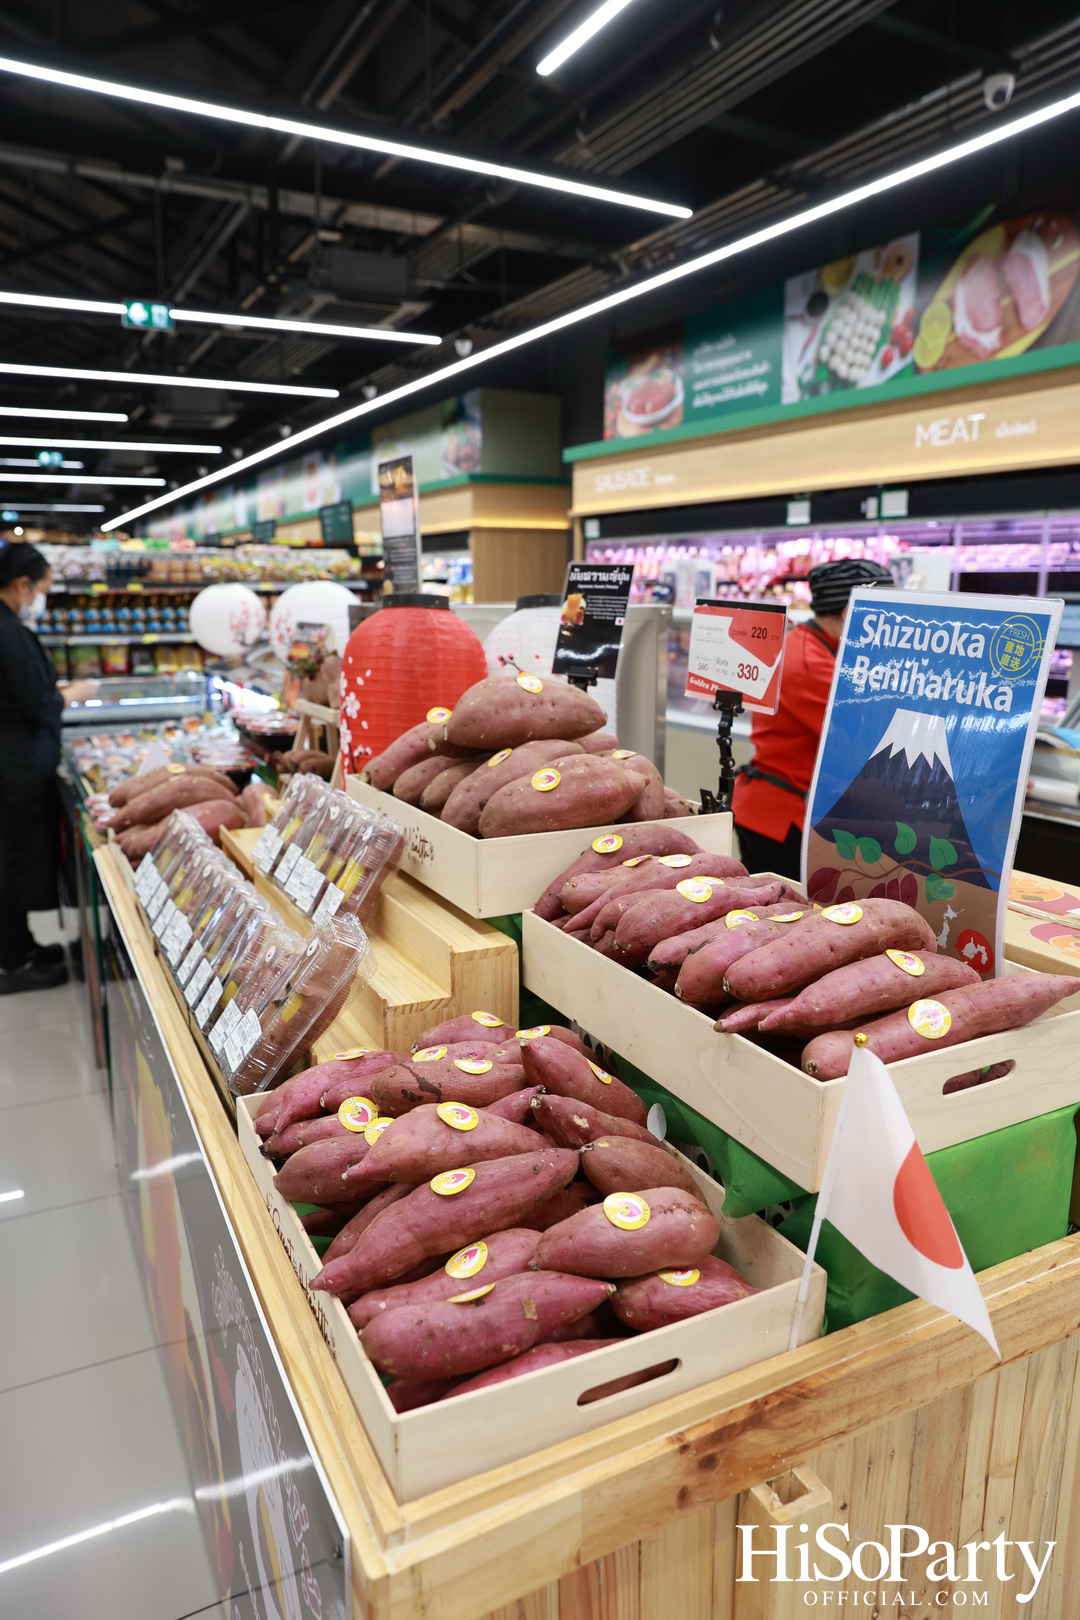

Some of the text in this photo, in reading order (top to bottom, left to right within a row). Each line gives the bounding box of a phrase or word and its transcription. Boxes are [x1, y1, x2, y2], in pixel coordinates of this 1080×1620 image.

[914, 412, 986, 449] MEAT
[751, 626, 768, 640] 220
[859, 612, 986, 660] Shizuoka
[1008, 626, 1031, 641] FRESH
[1000, 653, 1021, 669] 直送
[737, 663, 759, 682] 330
[689, 676, 710, 690] Golden
[852, 655, 1013, 713] Beniharuka
